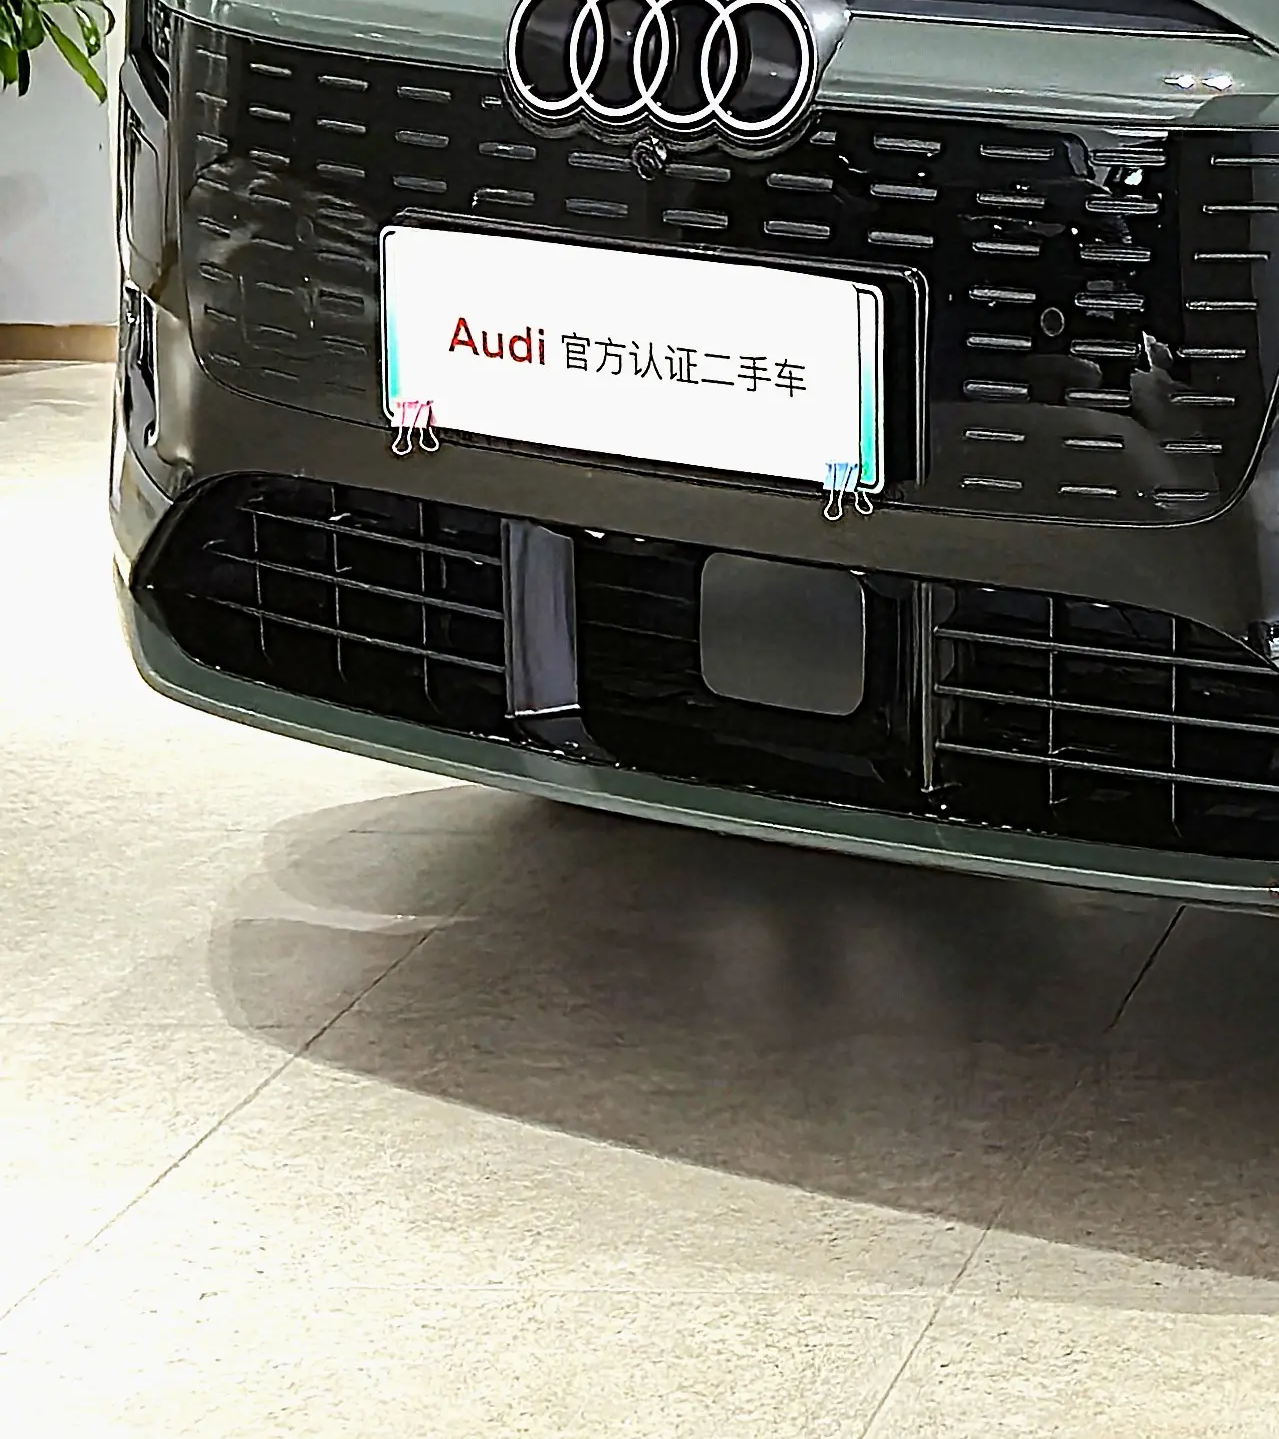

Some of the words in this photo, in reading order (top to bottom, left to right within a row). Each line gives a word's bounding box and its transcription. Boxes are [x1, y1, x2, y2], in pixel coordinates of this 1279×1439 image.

[447, 316, 547, 366] Audi
[560, 331, 808, 398] 官方认证二手车
